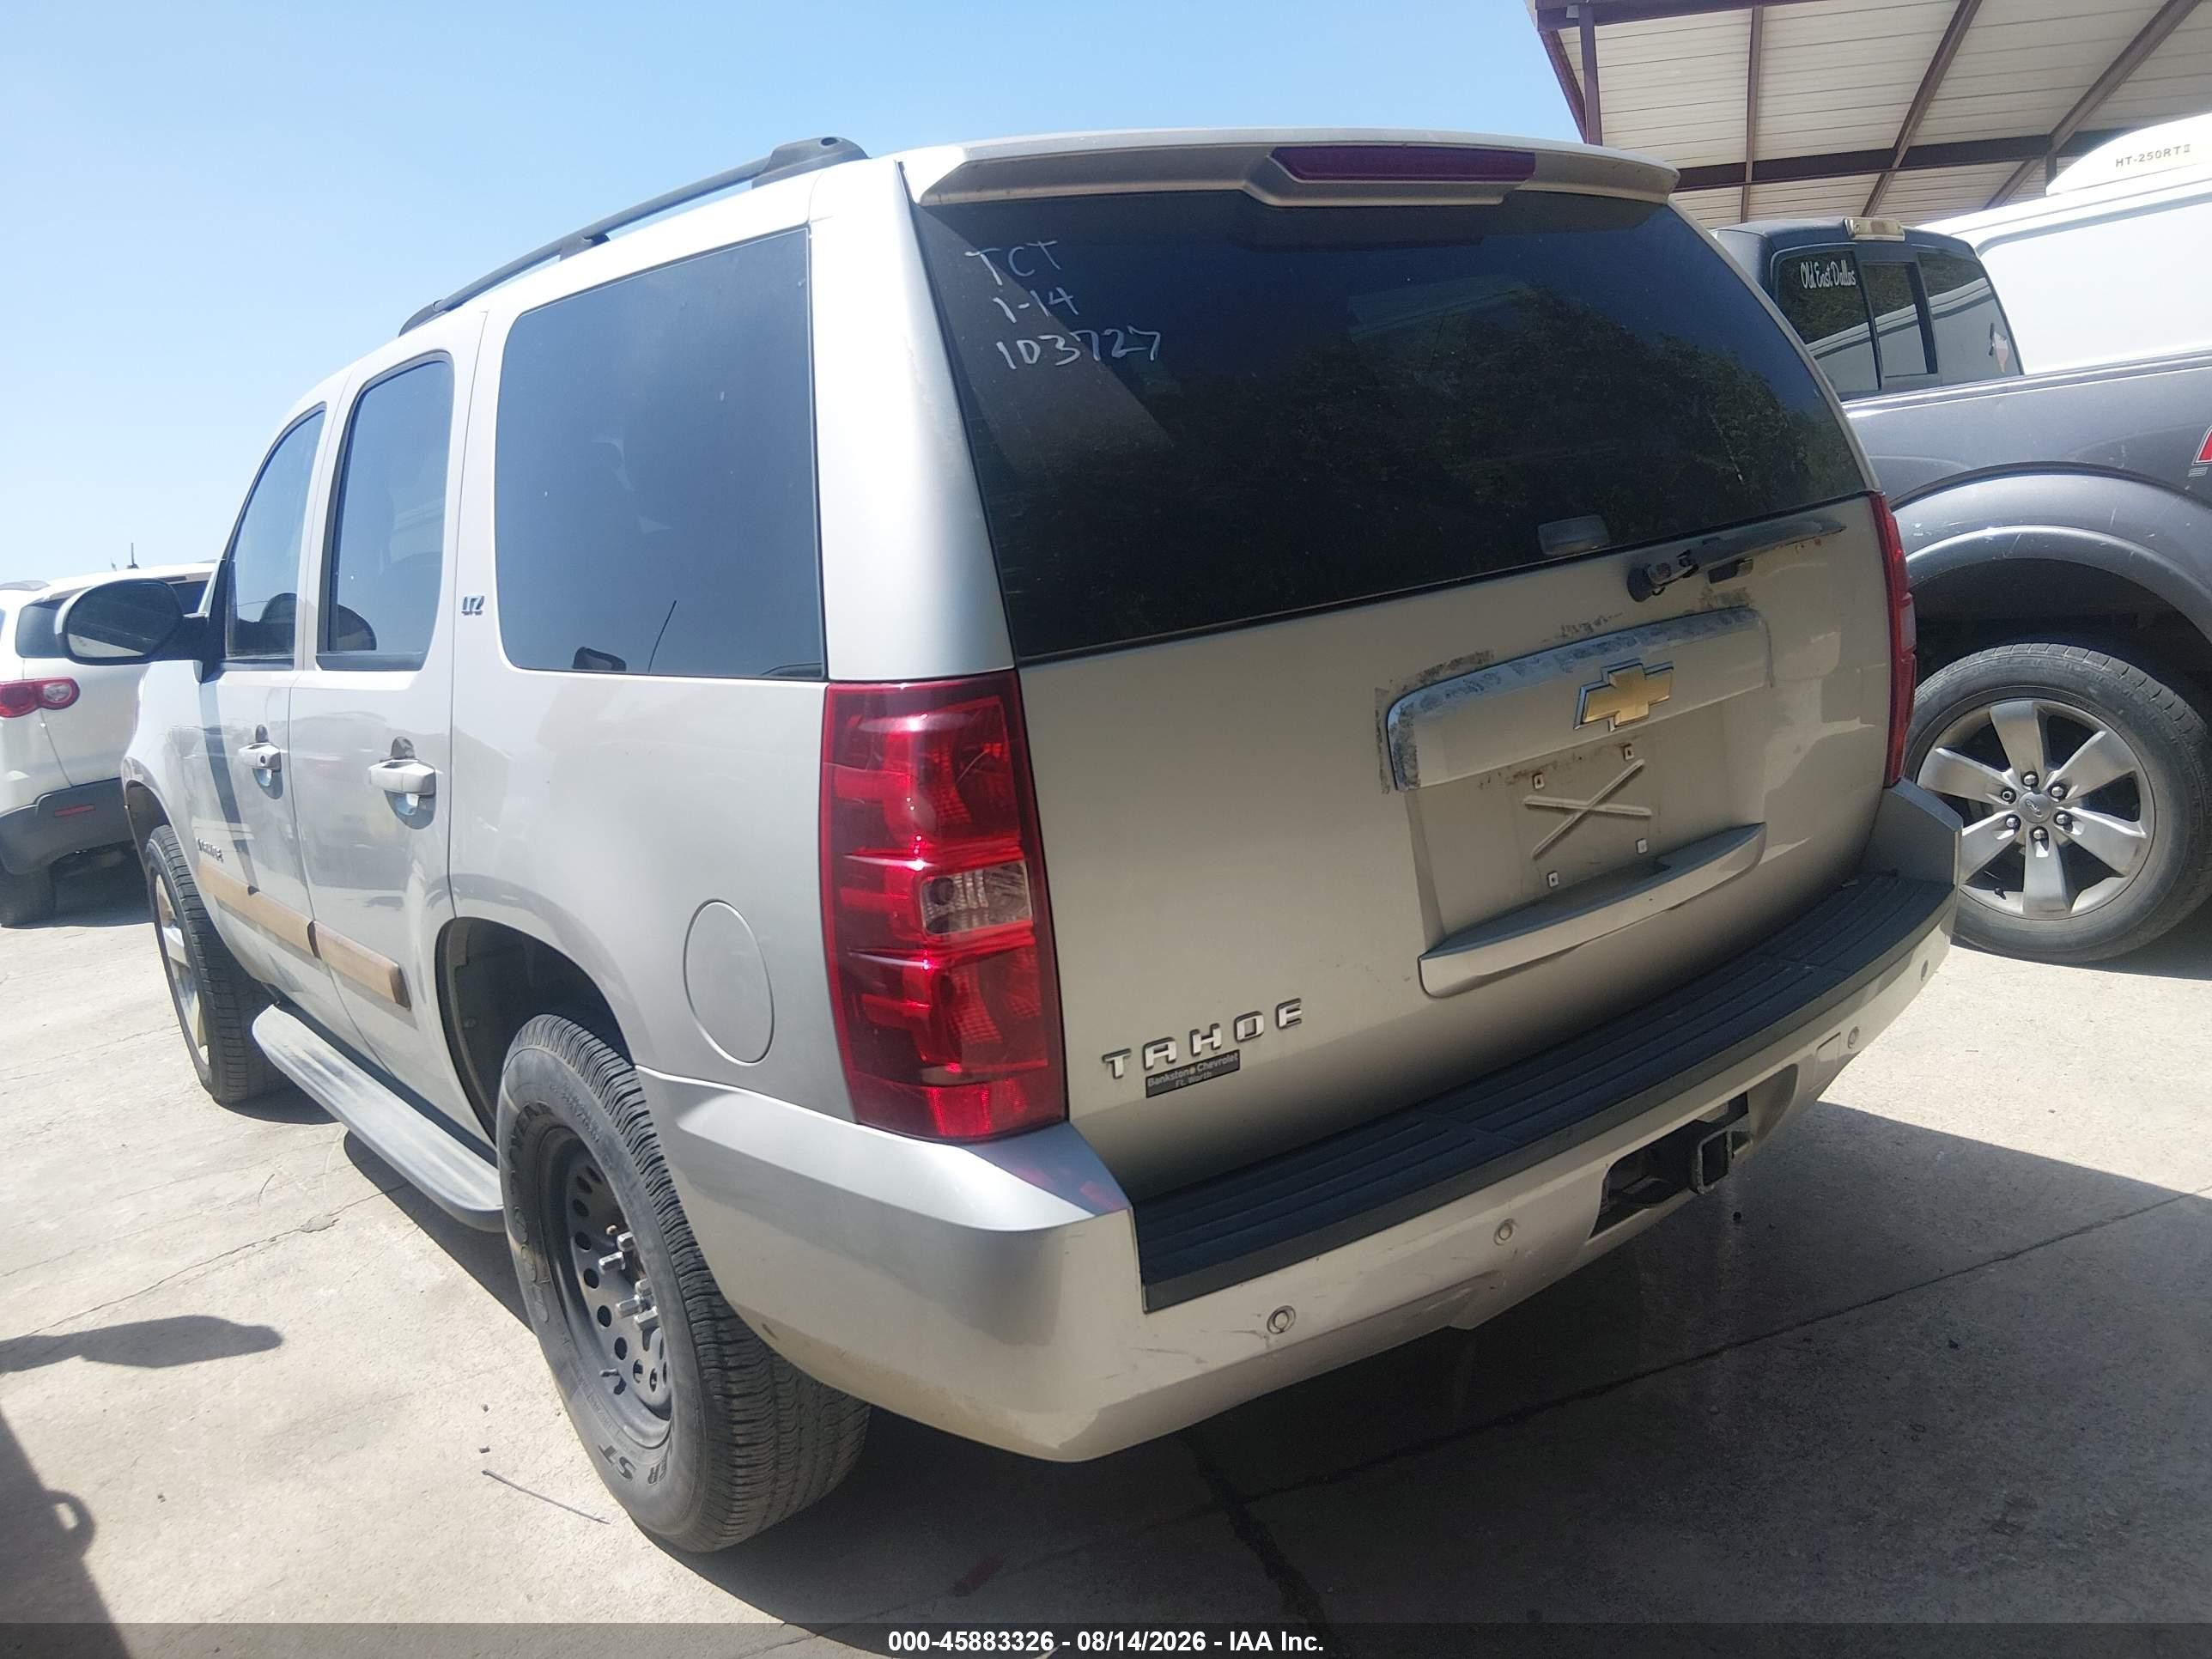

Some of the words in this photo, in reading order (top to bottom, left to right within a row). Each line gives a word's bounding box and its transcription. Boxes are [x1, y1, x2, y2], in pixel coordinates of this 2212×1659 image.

[964, 240, 1061, 286] TCT
[1800, 261, 1816, 289] Old
[1814, 261, 1832, 289] East
[1831, 259, 1856, 287] Dallas
[993, 287, 1079, 324] 1-14
[996, 325, 1161, 369] 103727
[1102, 997, 1303, 1079] TAHOE
[1147, 1068, 1190, 1087] Bankston
[1196, 1052, 1239, 1073] Chevrolet
